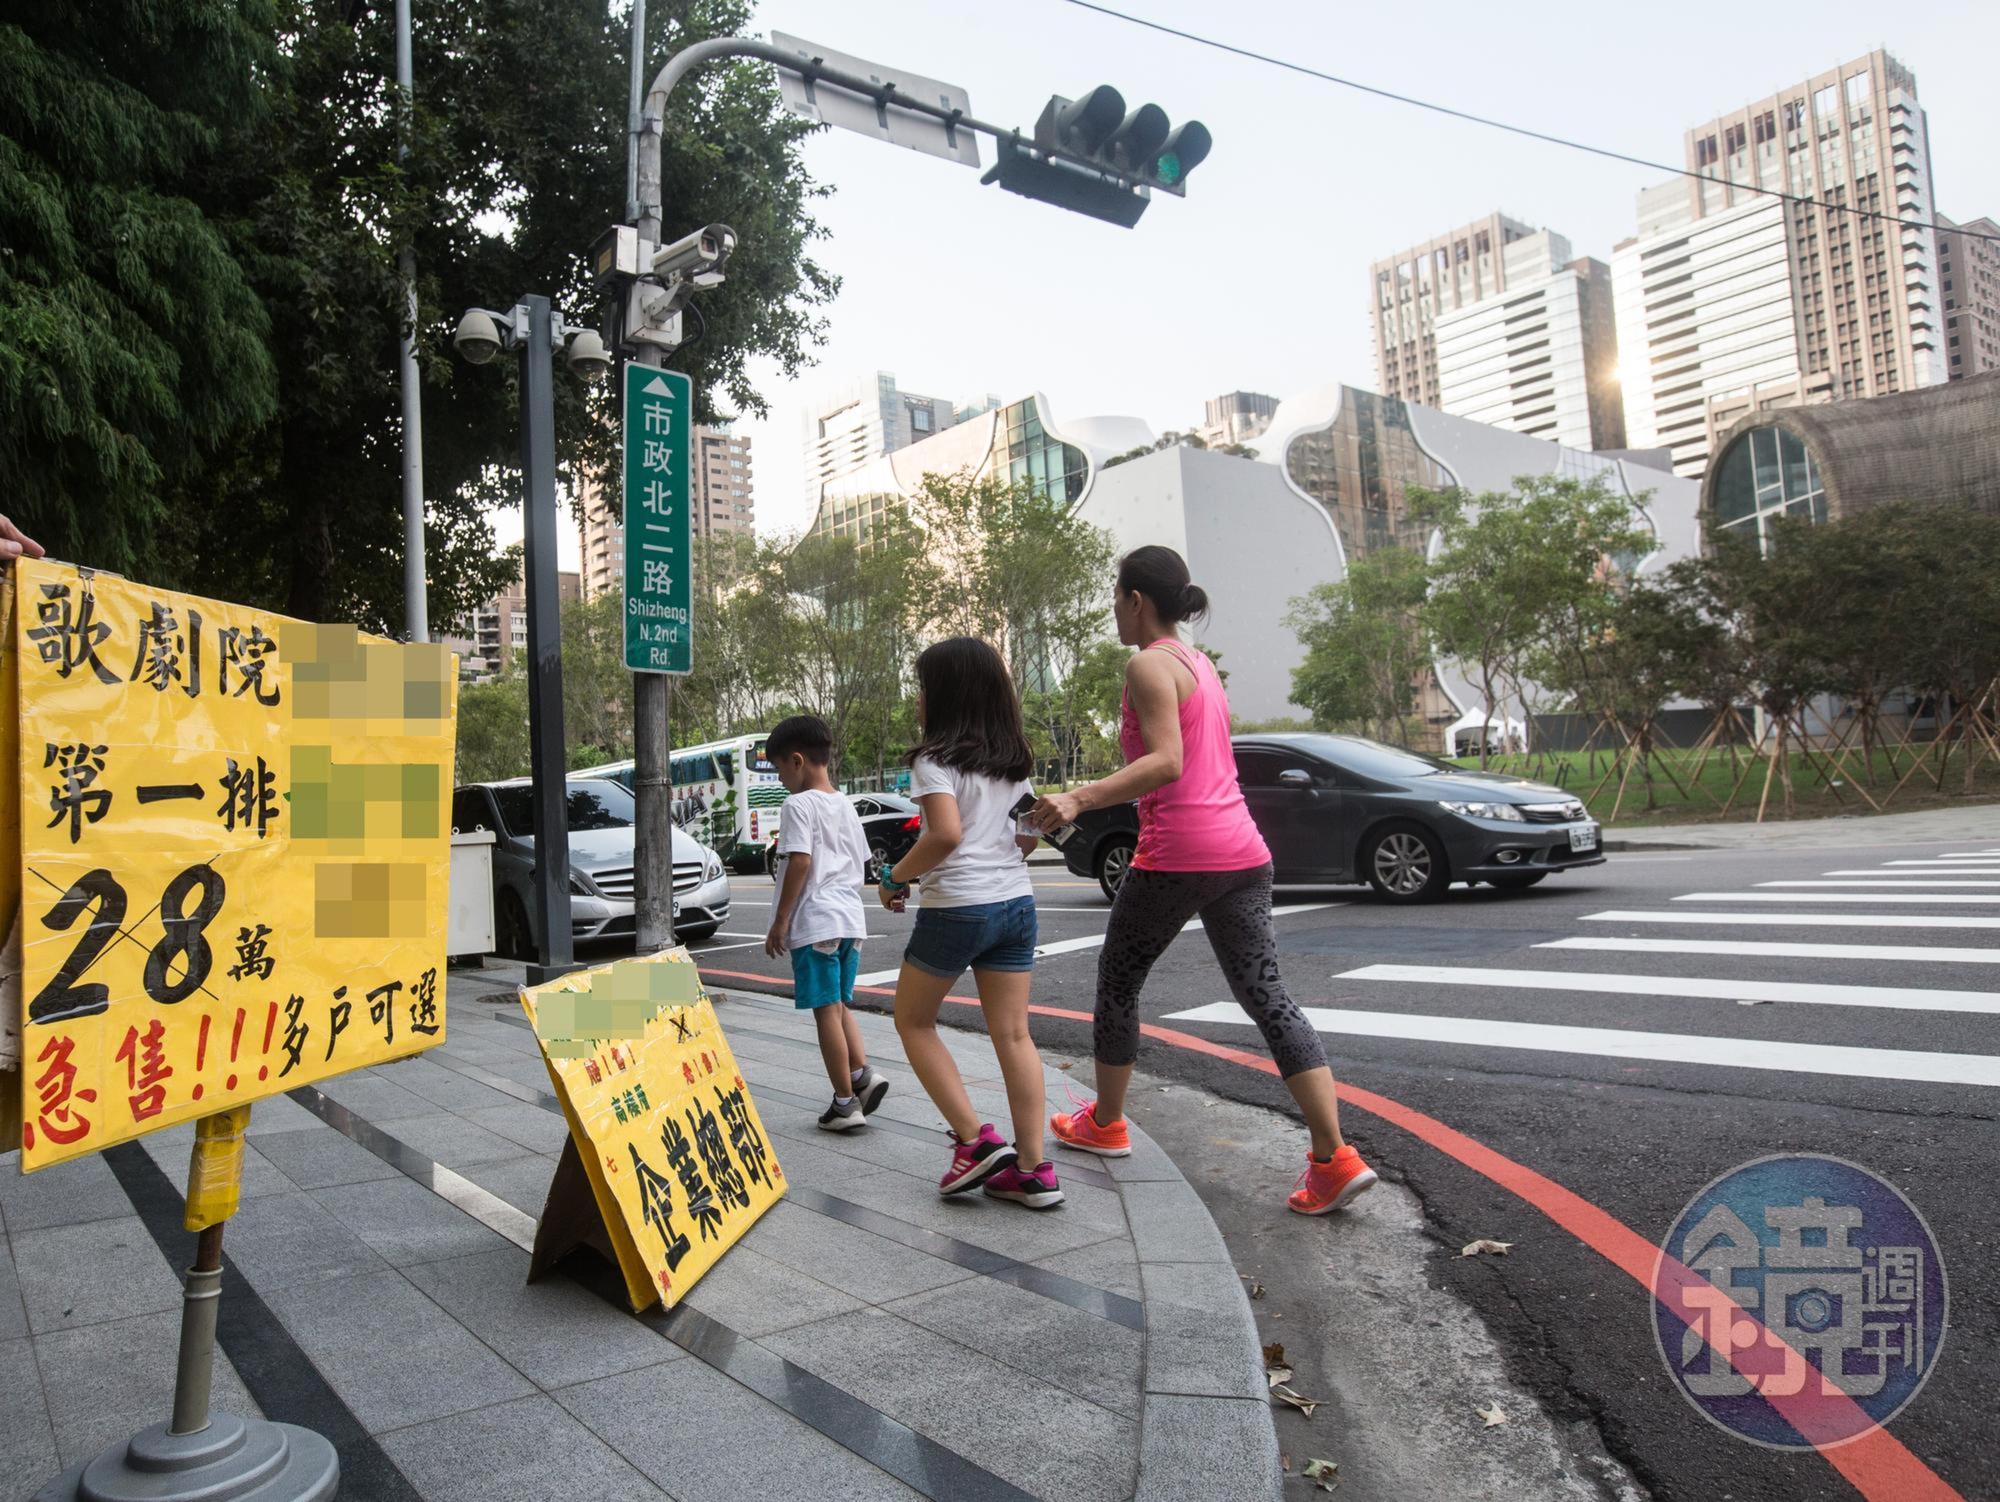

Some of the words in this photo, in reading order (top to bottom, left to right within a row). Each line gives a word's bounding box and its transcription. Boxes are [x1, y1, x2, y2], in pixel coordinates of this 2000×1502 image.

[642, 401, 674, 596] 市政北二路
[25, 583, 281, 707] 歌劇院
[628, 598, 687, 624] Shizheng
[650, 647, 671, 666] Rd.
[43, 742, 280, 844] 第一排
[278, 967, 440, 1078] 多戶可選
[628, 1086, 773, 1273] 企業總部
